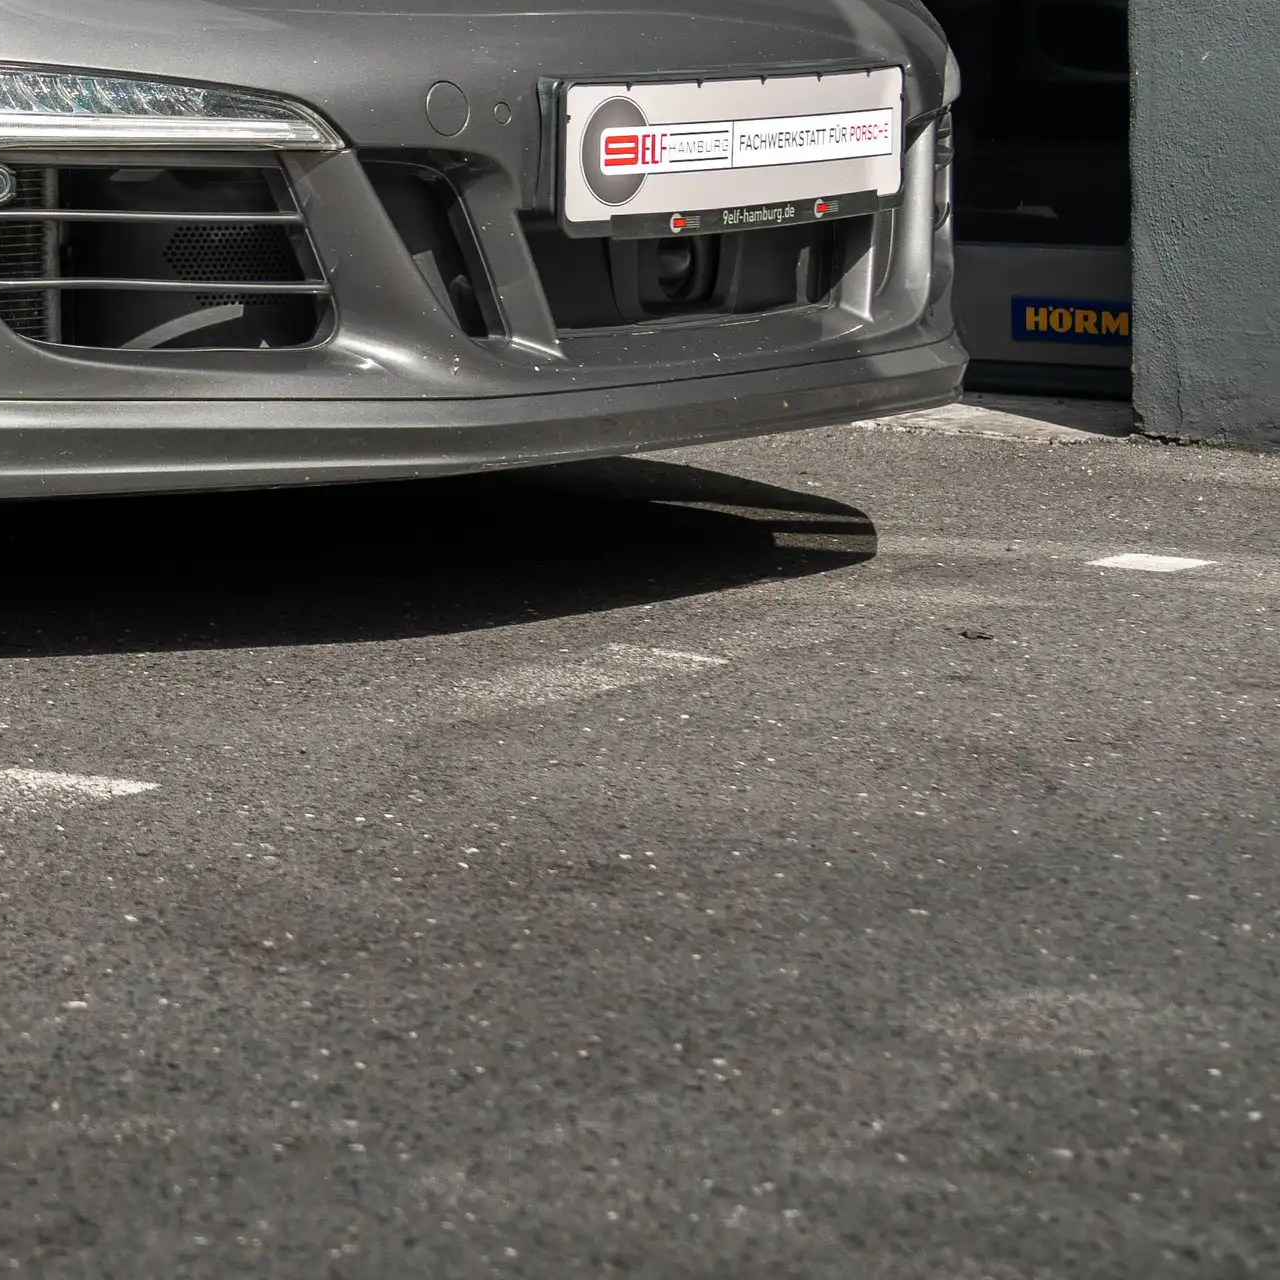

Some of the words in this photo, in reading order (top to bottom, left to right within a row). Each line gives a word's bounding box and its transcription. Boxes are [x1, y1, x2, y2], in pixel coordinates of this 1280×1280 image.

[669, 138, 729, 155] HAMBURG
[739, 128, 827, 152] FACHWERKSTATT
[829, 124, 848, 144] FÜR
[849, 122, 889, 141] PORSCHE
[722, 204, 795, 226] 9elf-hamburg.de
